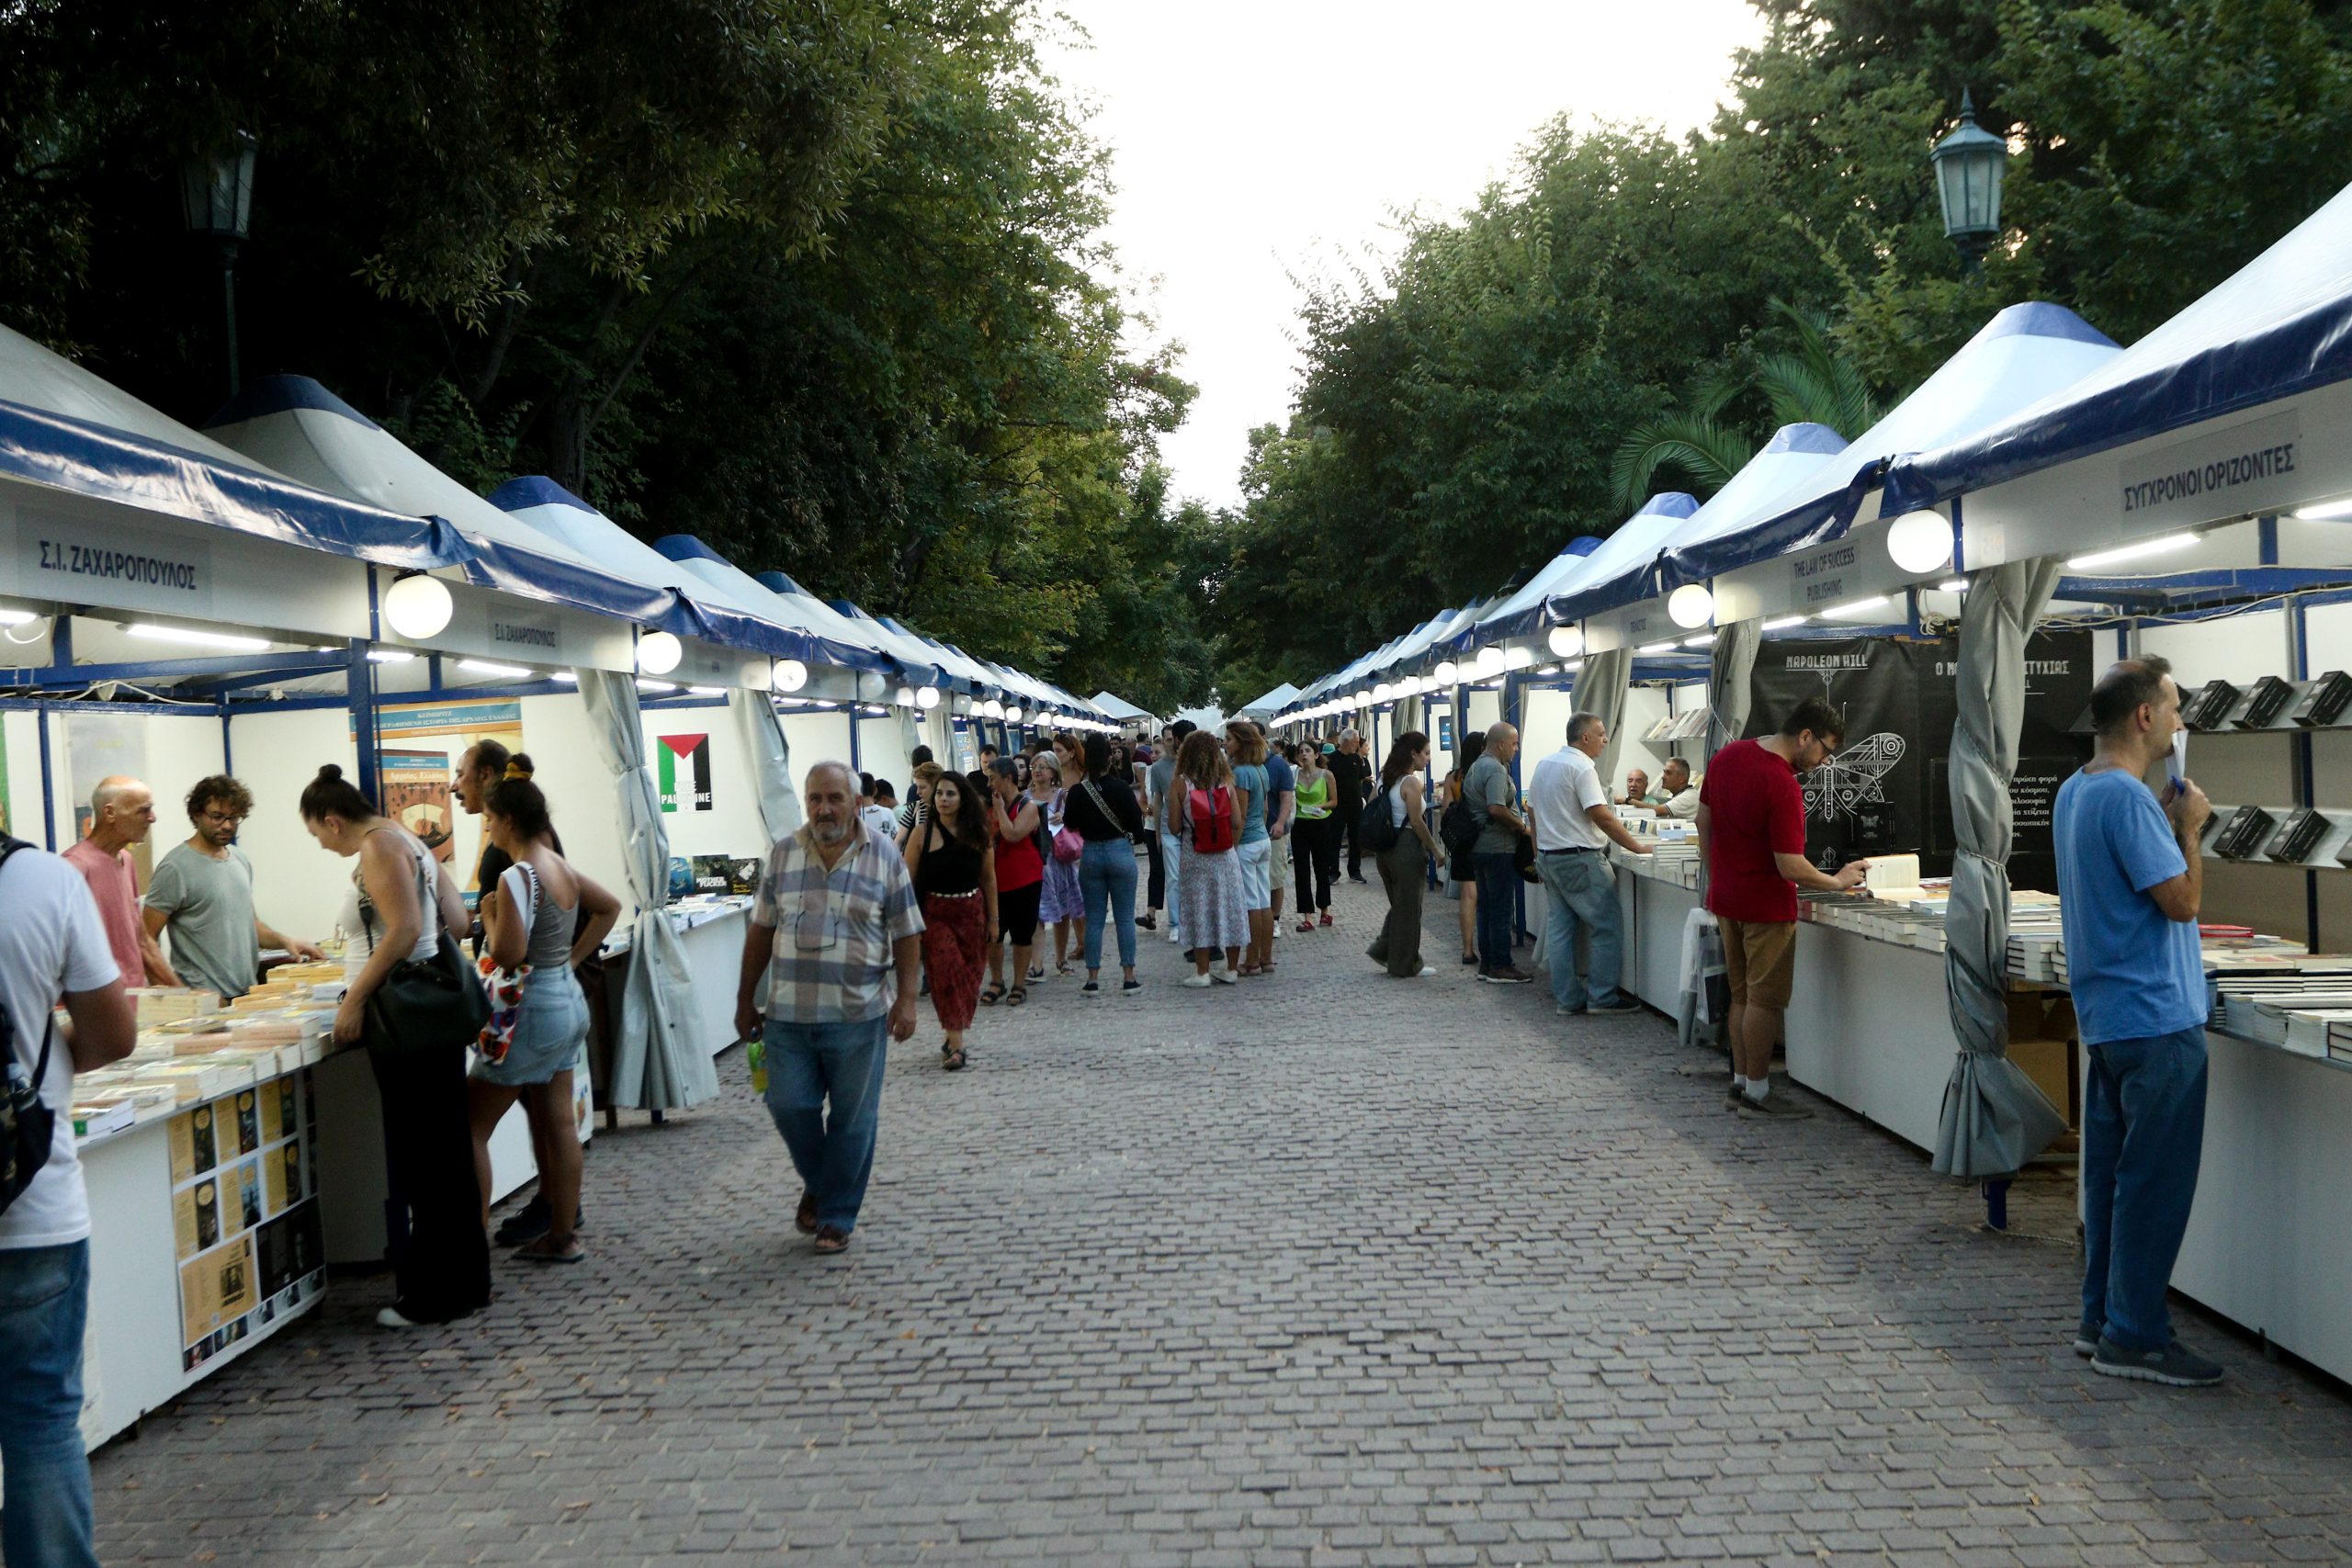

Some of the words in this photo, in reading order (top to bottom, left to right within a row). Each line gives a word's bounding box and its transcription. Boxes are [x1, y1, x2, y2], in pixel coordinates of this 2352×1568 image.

[2124, 468, 2201, 512] ΣΥΓΧΡΟΝΟΙ
[2205, 443, 2295, 491] ΟΡΙΖΟΝΤΕΣ
[40, 540, 67, 570] Σ.Ι.
[71, 546, 197, 590] ΖΑΧΑΡΟΠΟΥΛΟΣ
[1794, 561, 1805, 580] THE
[1806, 557, 1818, 576] LAW
[1819, 555, 1827, 571] OF
[1827, 547, 1855, 570] SUCCESS
[1807, 579, 1843, 603] PUBLISHING
[1785, 655, 1840, 668] NAPOLEON
[1843, 654, 1869, 667] HILL
[2013, 775, 2037, 784] πρώτη
[2039, 774, 2058, 784] φορά
[2020, 786, 2050, 795] κόσμου,
[662, 793, 711, 805] PALINE
[2013, 818, 2050, 827] οσωπικής
